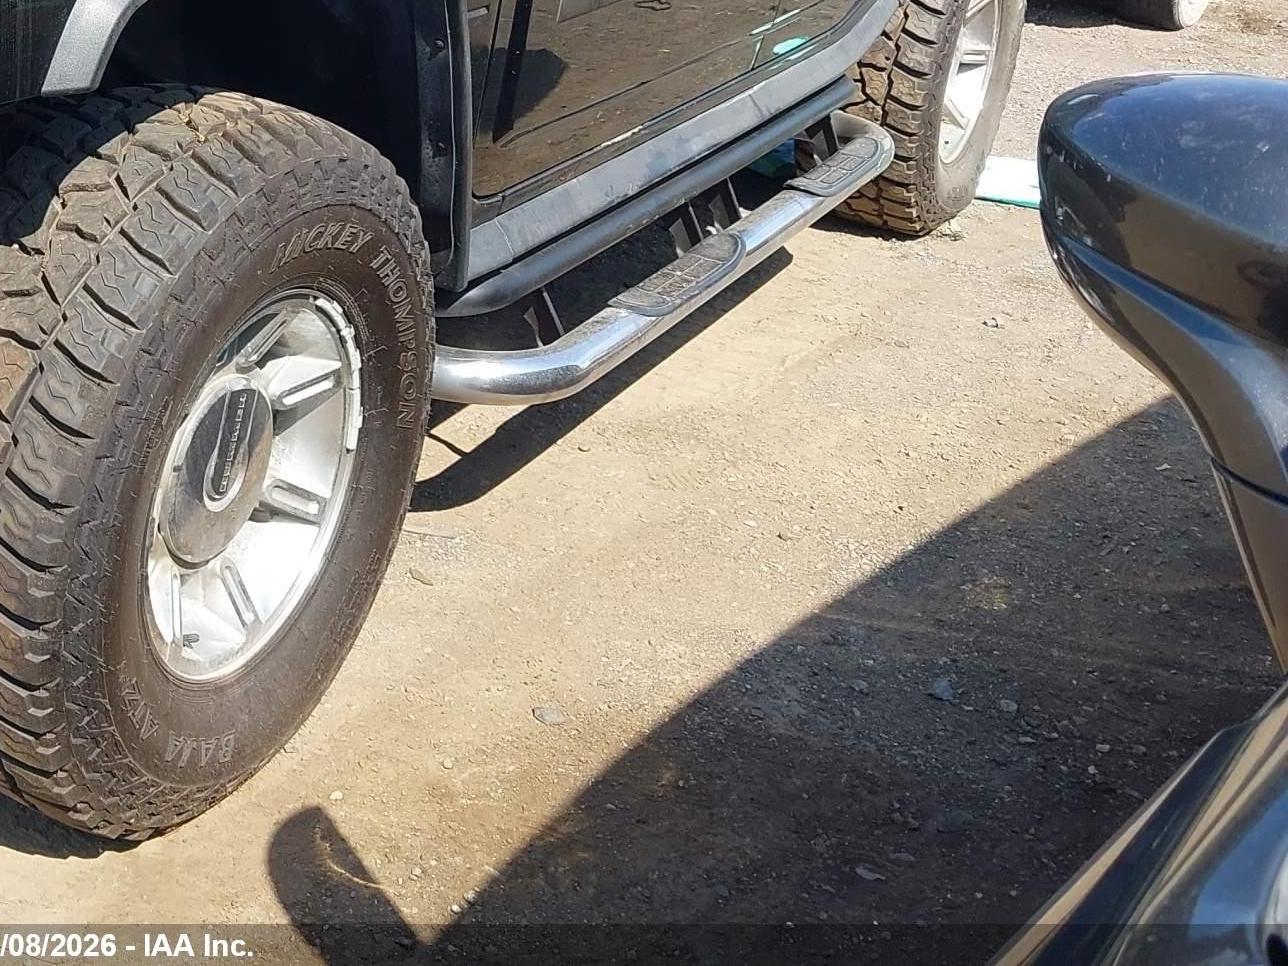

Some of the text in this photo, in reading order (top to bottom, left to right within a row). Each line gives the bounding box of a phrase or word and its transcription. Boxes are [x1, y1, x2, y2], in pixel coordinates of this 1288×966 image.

[268, 220, 418, 429] MICKEY THOMPSON
[164, 729, 236, 769] BAJA
